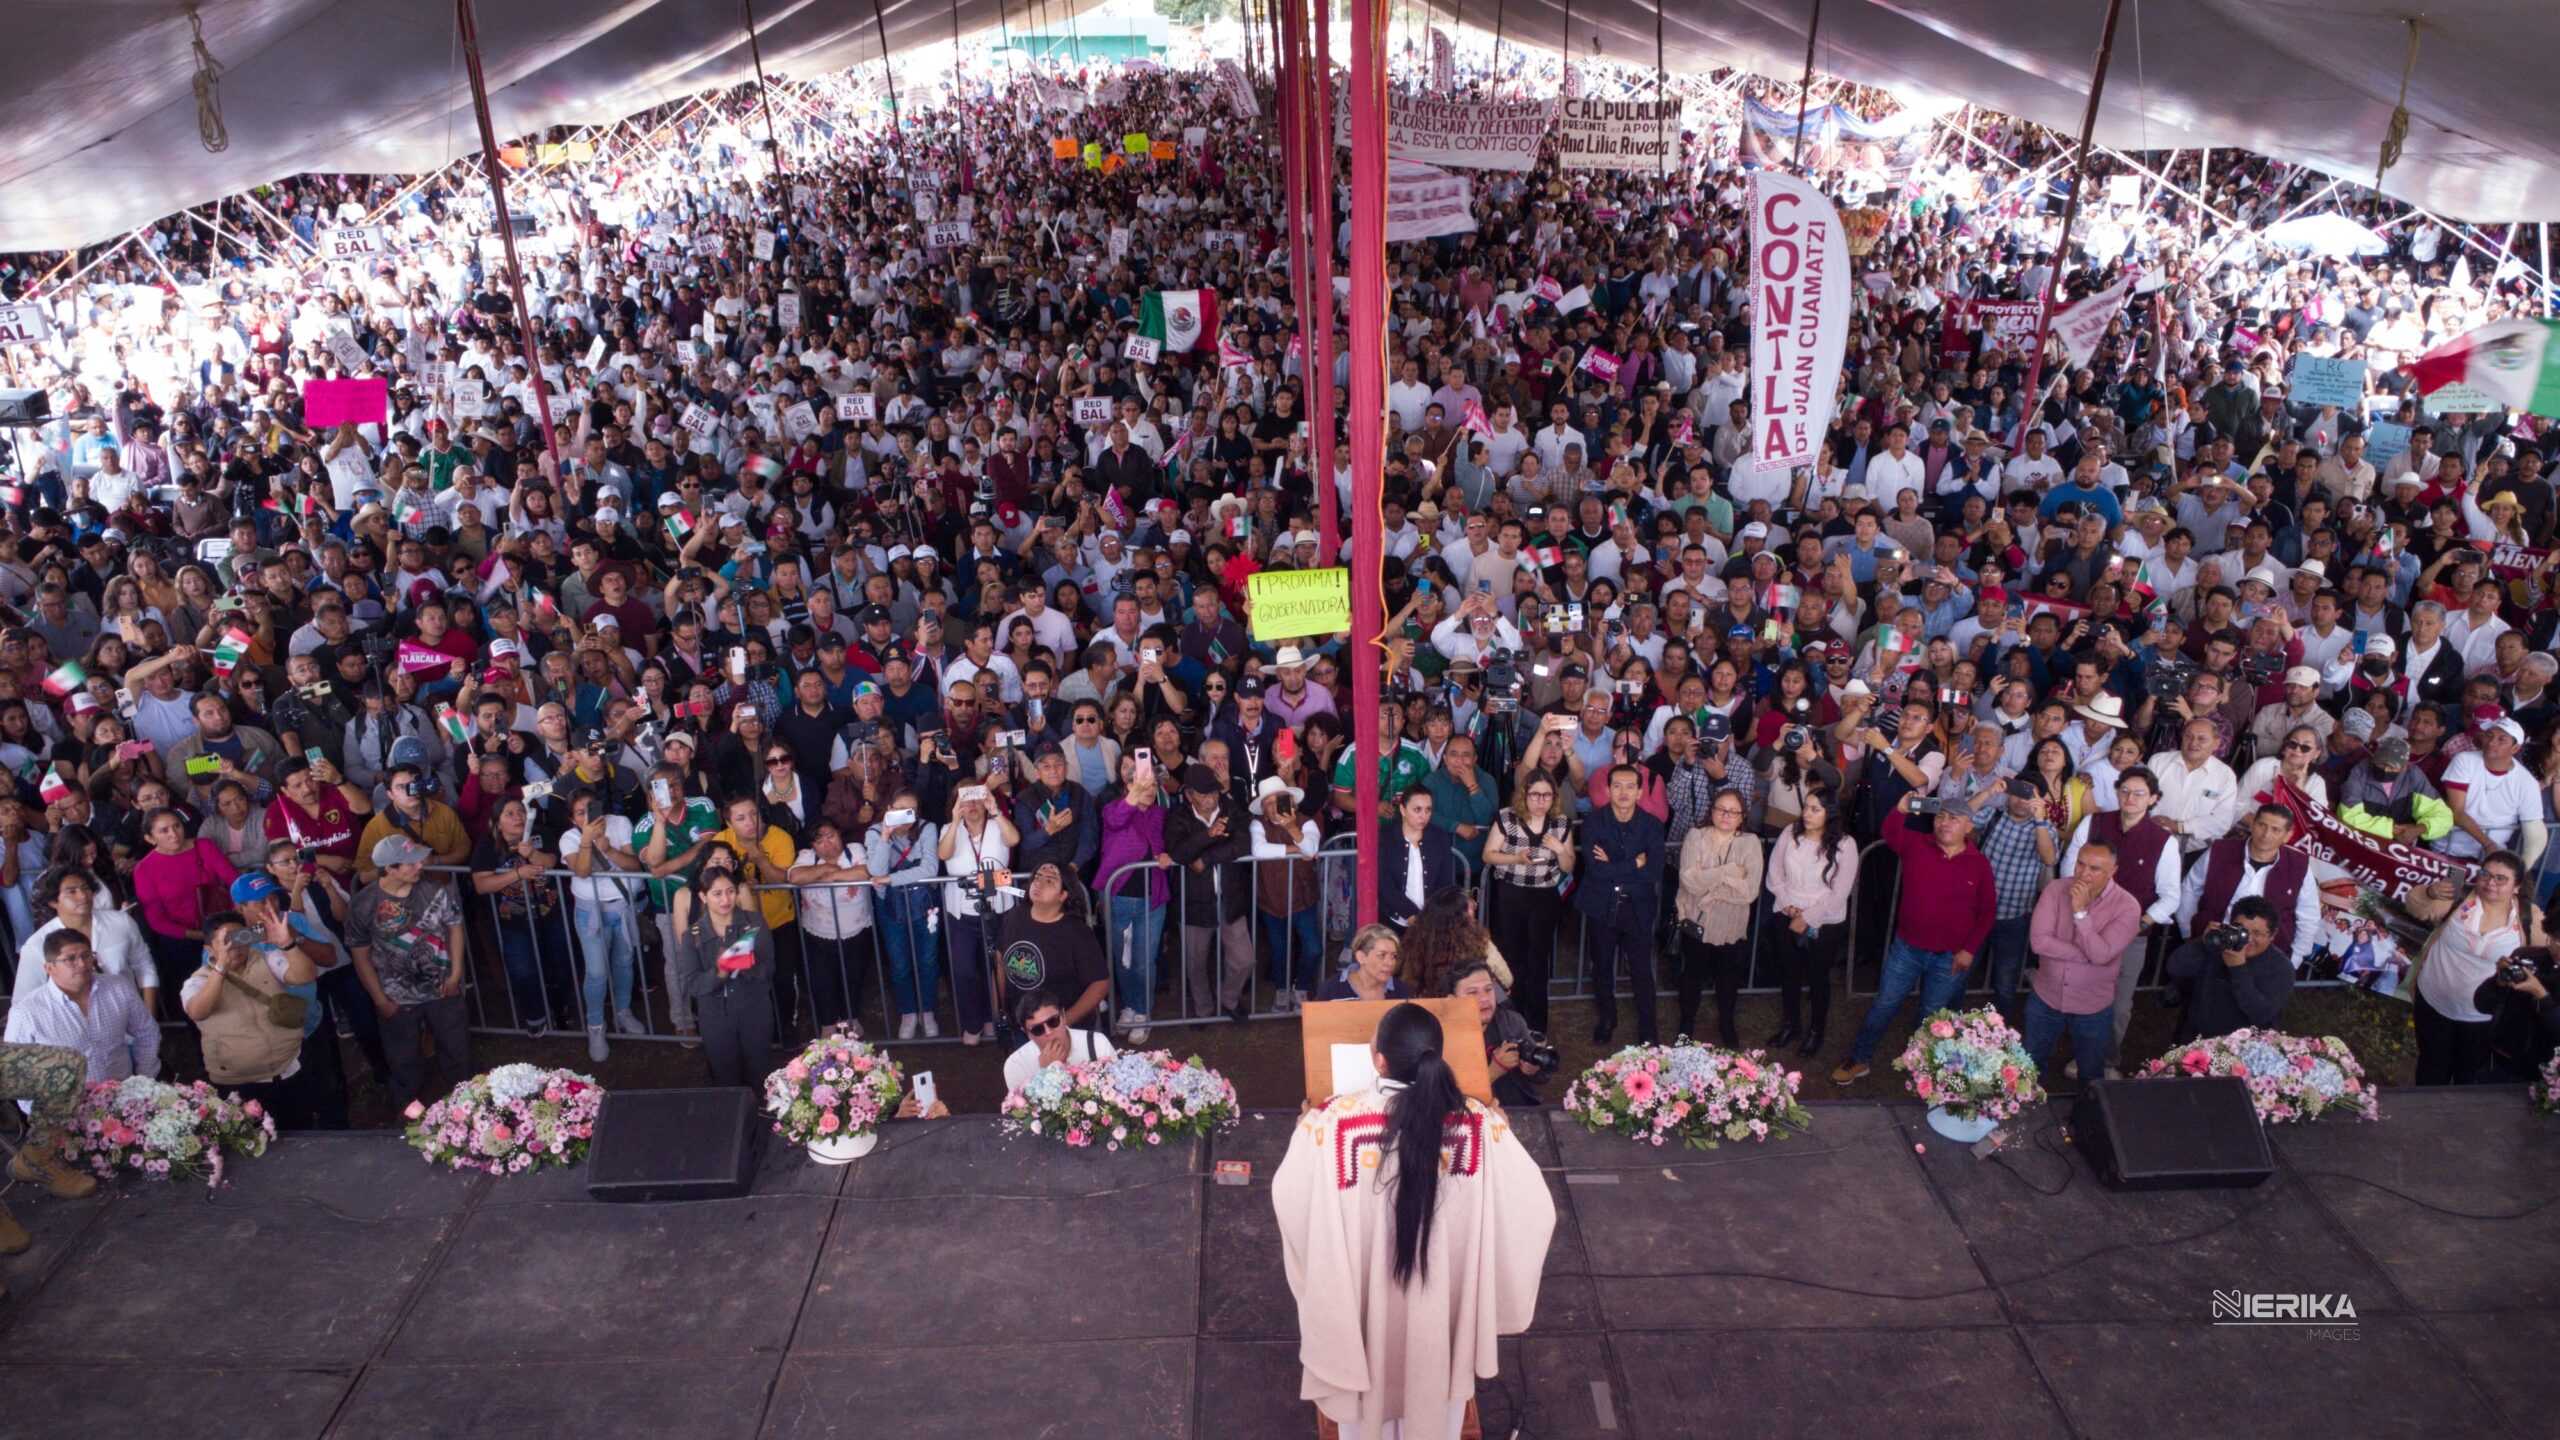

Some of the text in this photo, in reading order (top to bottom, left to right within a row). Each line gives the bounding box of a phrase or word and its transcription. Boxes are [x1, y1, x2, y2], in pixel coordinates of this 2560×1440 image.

[1415, 101, 1469, 120] RIVERA
[1477, 101, 1542, 121] RIVERA
[1403, 113, 1466, 134] COSECHAR
[1469, 121, 1477, 134] Y
[1479, 119, 1546, 135] DEFENDER
[1562, 120, 1607, 132] PRESENTE
[1412, 131, 1450, 150] ESTA
[1560, 133, 1669, 155] Ana Lilia Rivera
[912, 179, 936, 189] BAL
[337, 230, 366, 240] RED
[937, 224, 959, 232] RED
[334, 239, 375, 255] BAL
[935, 232, 965, 244] BAL
[652, 260, 671, 270] BAL
[1798, 220, 1826, 349] CUAMATZI
[1977, 304, 2042, 315] PROYECTO
[0, 323, 34, 341] AL
[1761, 193, 1801, 460] CONTLA
[1129, 345, 1151, 359] BAL
[1792, 355, 1814, 415] JUAN
[843, 405, 868, 417] BAL
[1083, 400, 1103, 408] RED
[1080, 408, 1107, 420] BAL
[686, 415, 705, 434] BAL
[1260, 597, 1347, 622] GOBERNADORA
[2308, 801, 2381, 852] Santa
[2388, 843, 2451, 876] Cruz
[2295, 833, 2336, 863] Ana
[2394, 866, 2441, 889] cont
